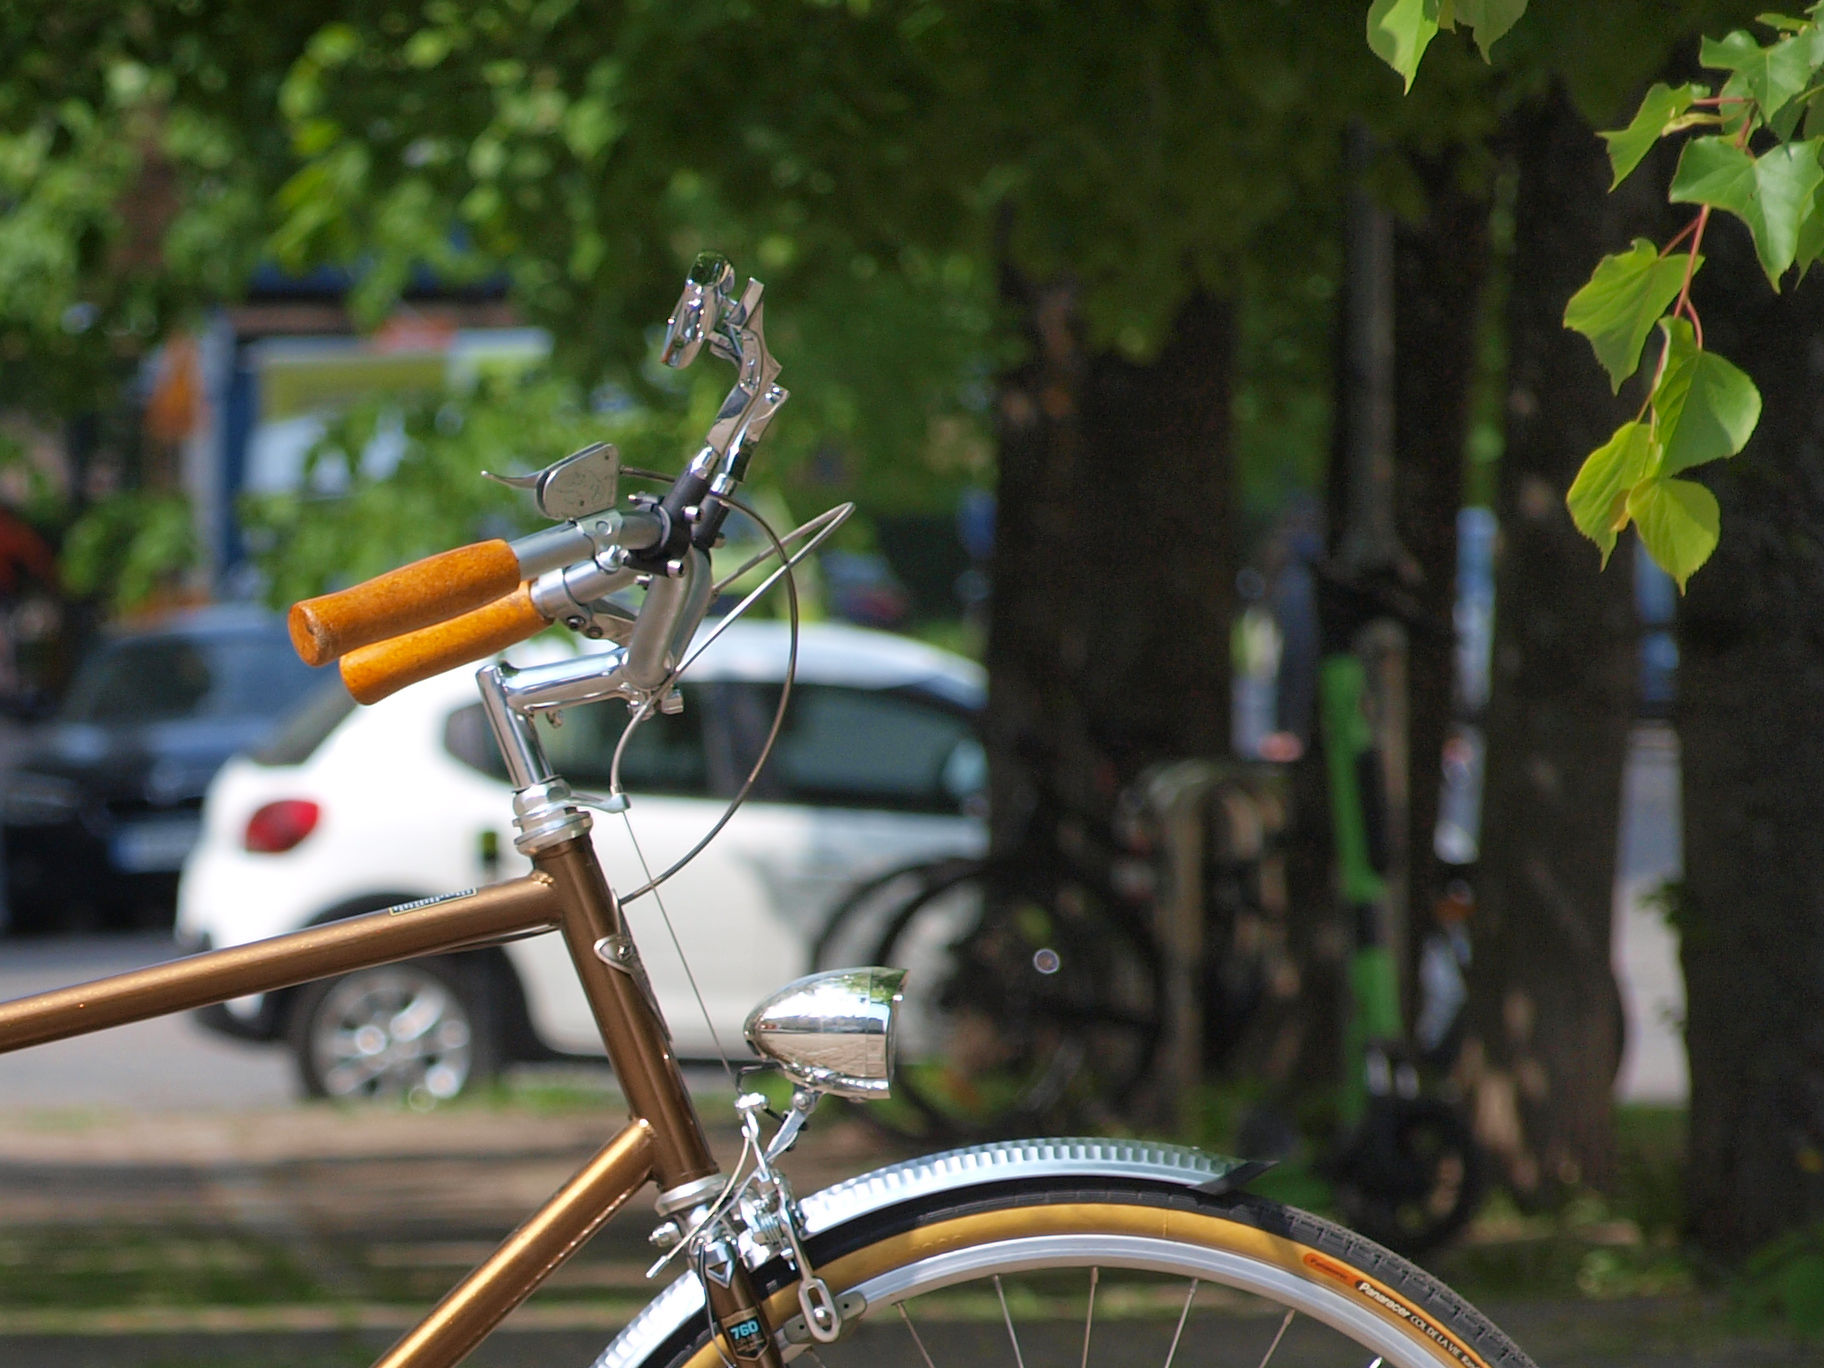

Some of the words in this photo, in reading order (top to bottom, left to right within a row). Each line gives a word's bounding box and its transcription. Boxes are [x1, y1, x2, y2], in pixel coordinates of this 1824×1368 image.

[730, 1320, 759, 1340] 760
[1359, 1282, 1411, 1318] Panaracer
[1410, 1315, 1429, 1332] COL
[1426, 1326, 1440, 1341] DE
[1436, 1335, 1448, 1349] LA
[1447, 1344, 1463, 1358] VIE
